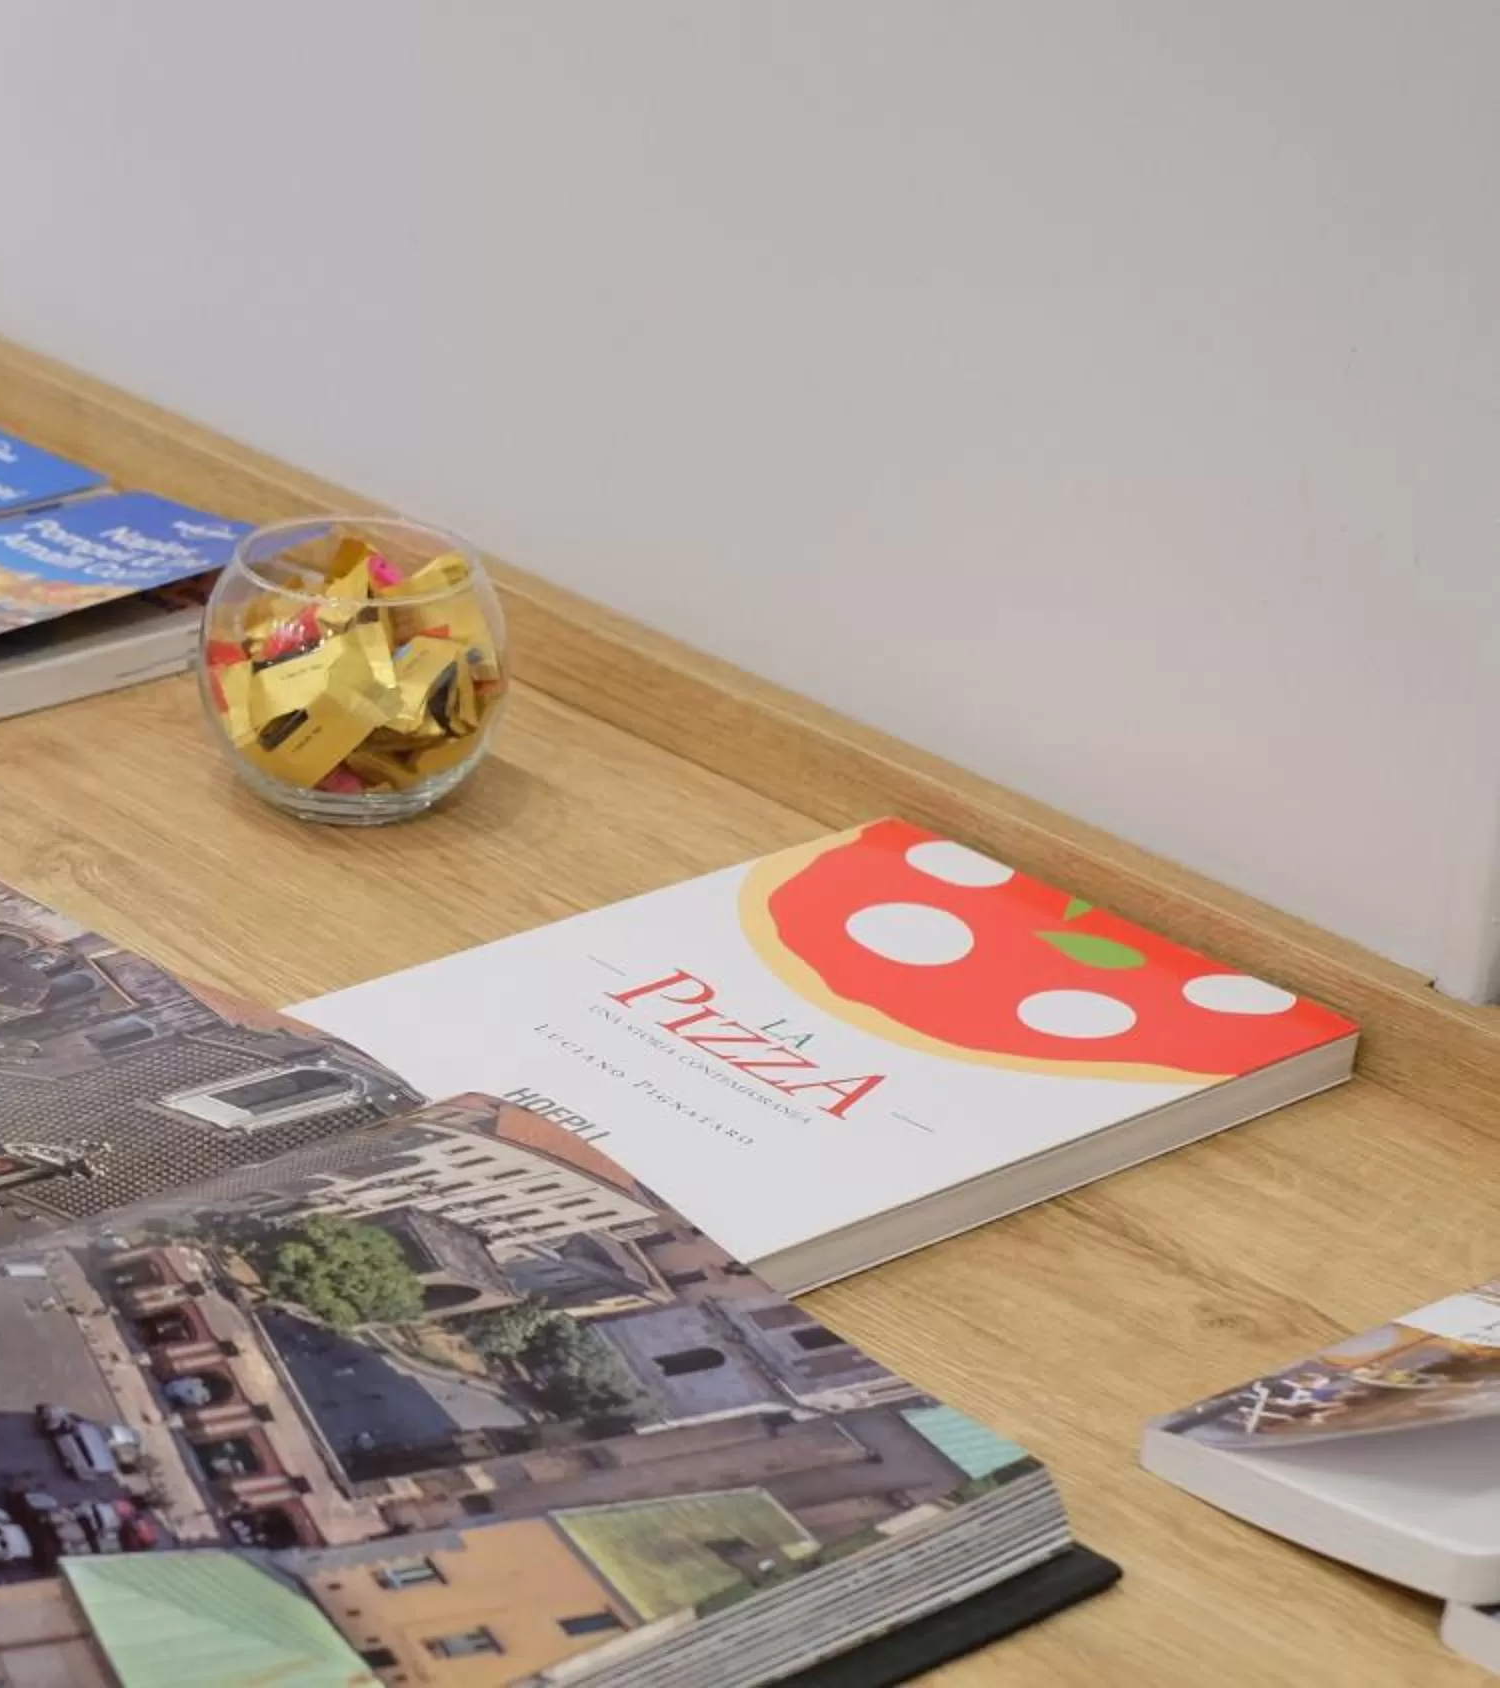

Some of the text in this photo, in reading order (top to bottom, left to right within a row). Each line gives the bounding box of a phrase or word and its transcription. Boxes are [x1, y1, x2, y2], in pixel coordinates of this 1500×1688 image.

[588, 1003, 623, 1026] UNA
[603, 967, 889, 1121] PIZZA
[758, 1016, 818, 1050] LA
